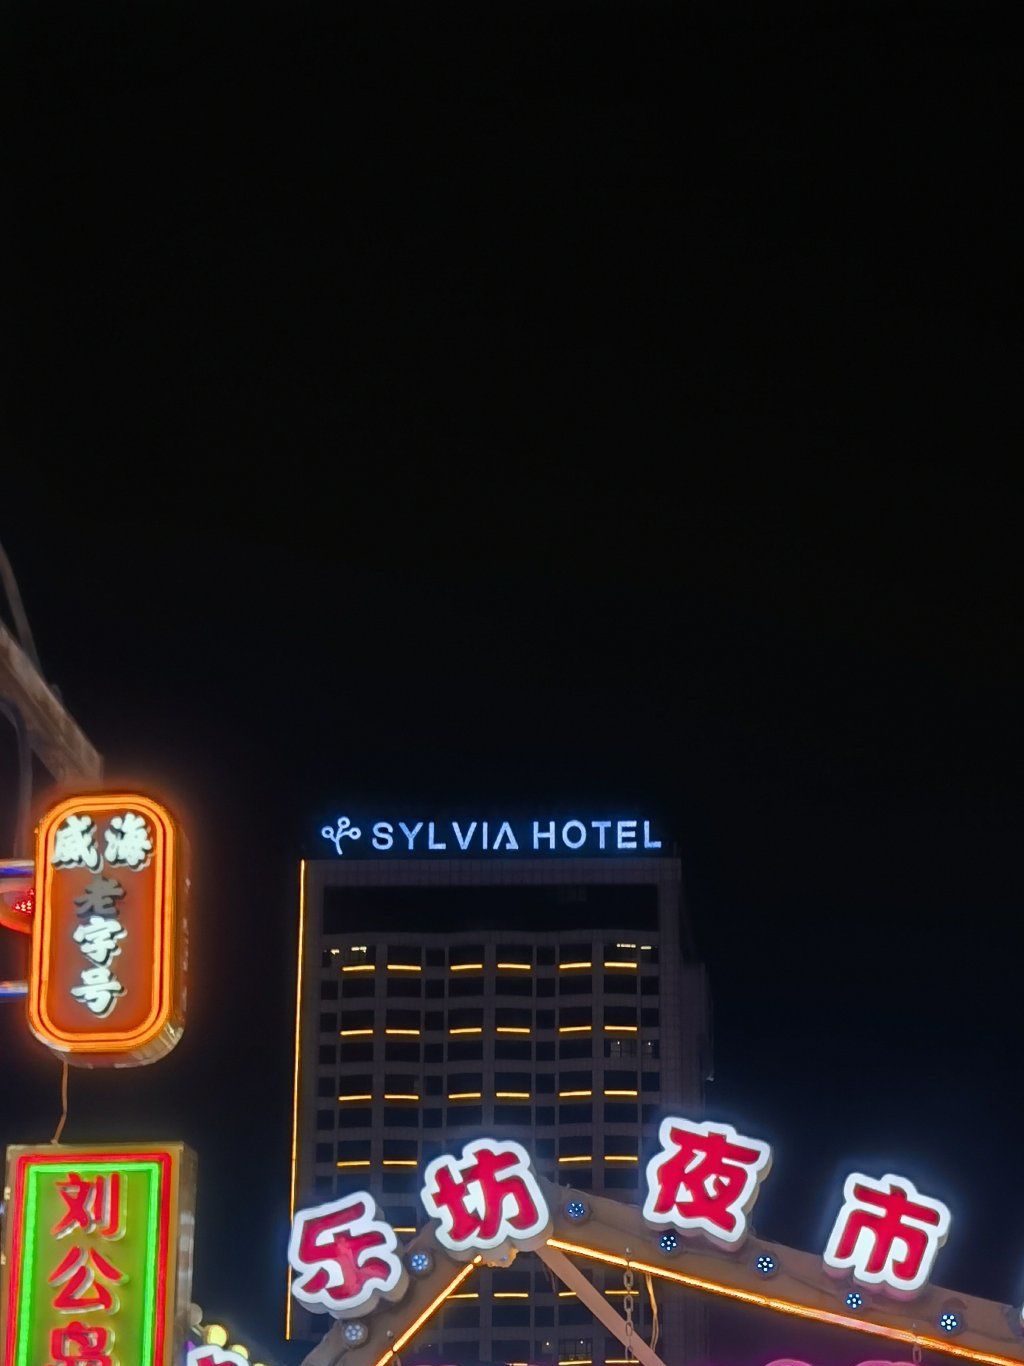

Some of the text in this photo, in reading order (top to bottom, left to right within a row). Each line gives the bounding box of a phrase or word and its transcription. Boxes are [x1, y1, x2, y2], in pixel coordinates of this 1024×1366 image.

[53, 812, 152, 872] 威海
[372, 820, 662, 851] SYLVIA HOTEL
[71, 874, 128, 1018] 老字号
